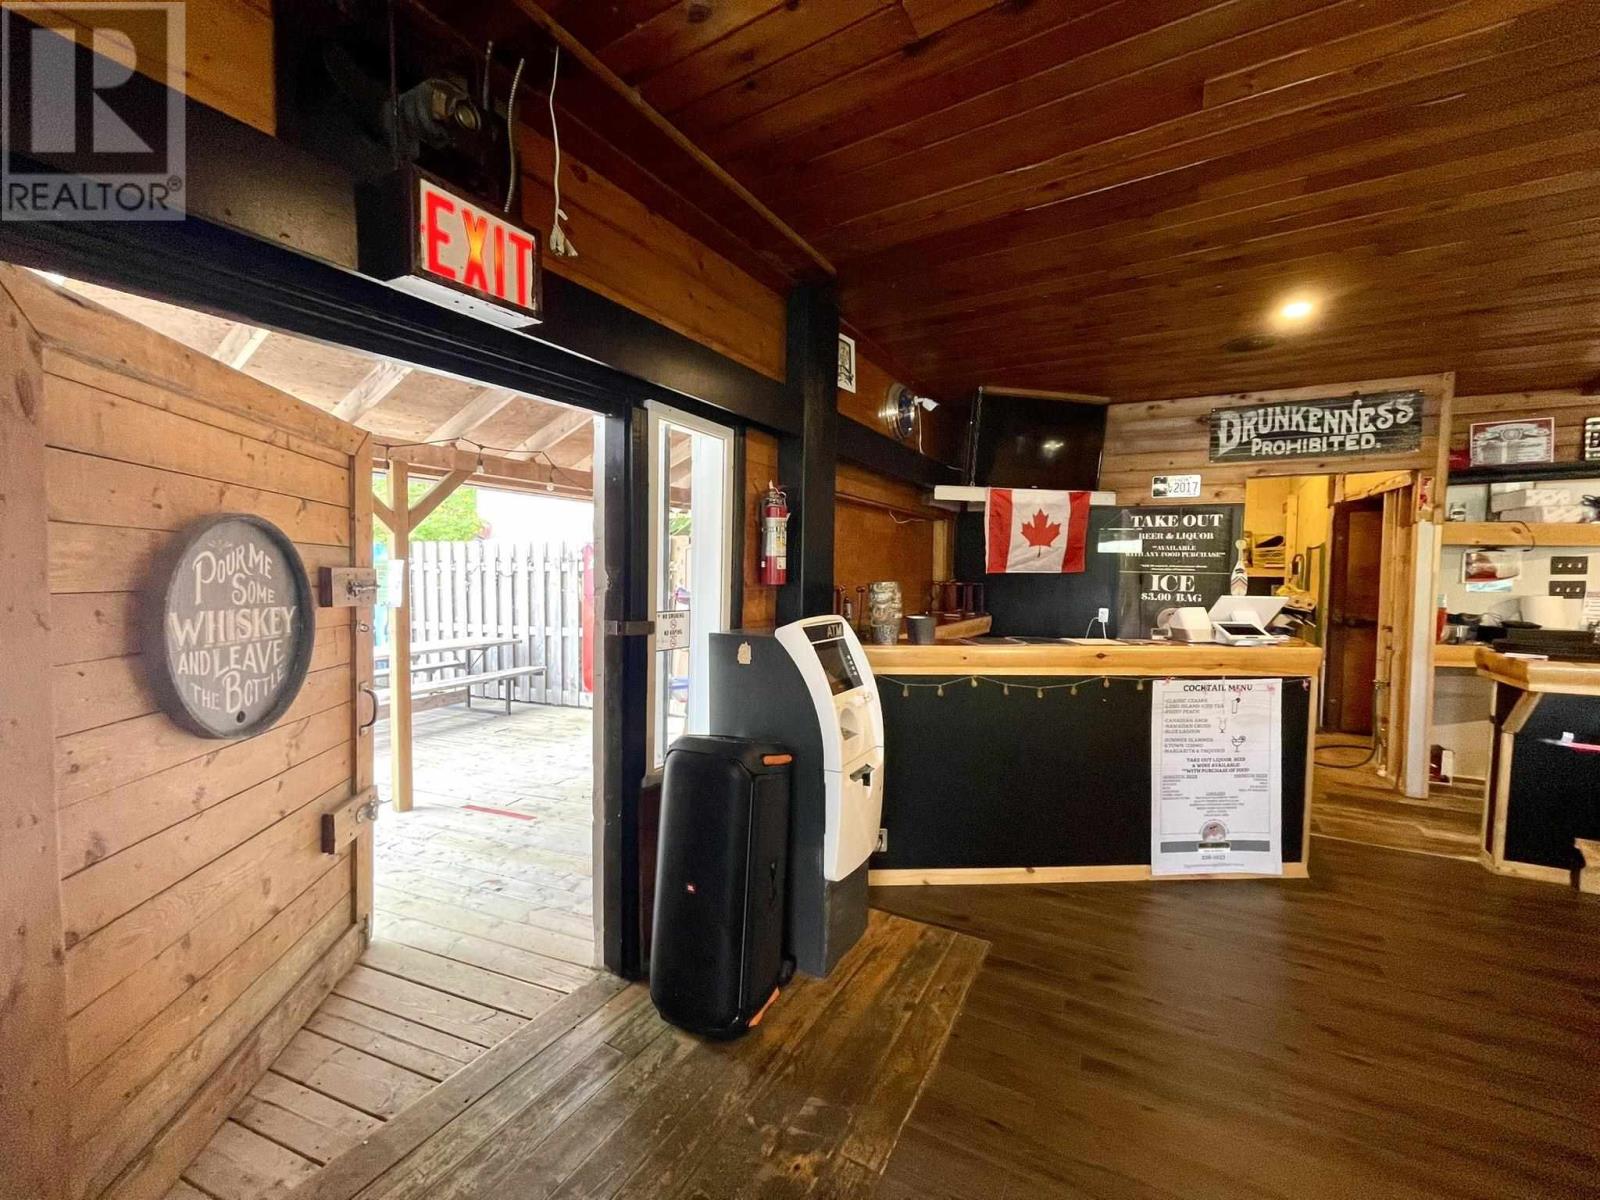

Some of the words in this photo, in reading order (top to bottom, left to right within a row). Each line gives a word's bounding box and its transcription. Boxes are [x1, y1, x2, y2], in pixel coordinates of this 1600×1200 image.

[426, 191, 533, 308] EXIT
[1217, 396, 1414, 457] DRUNKENNESS
[1251, 433, 1382, 456] PROHIBITED.
[1130, 514, 1179, 528] TAKE
[1182, 513, 1224, 527] OUT
[1138, 532, 1164, 540] BEER
[1165, 532, 1175, 540] &
[1175, 532, 1215, 541] LIQUOR
[192, 545, 250, 605] POUR
[249, 543, 273, 580] ME
[1150, 574, 1196, 592] ICE
[232, 573, 275, 606] SOME
[1175, 593, 1202, 602] BAG
[169, 606, 297, 647] WHISKEY
[827, 624, 843, 638] ATM
[177, 651, 211, 676] AND
[212, 640, 285, 679] LEAVE
[191, 682, 222, 711] THE
[223, 665, 286, 714] BOTTLE
[1183, 684, 1227, 692] COCKTAIL
[1228, 683, 1253, 692] MENU
